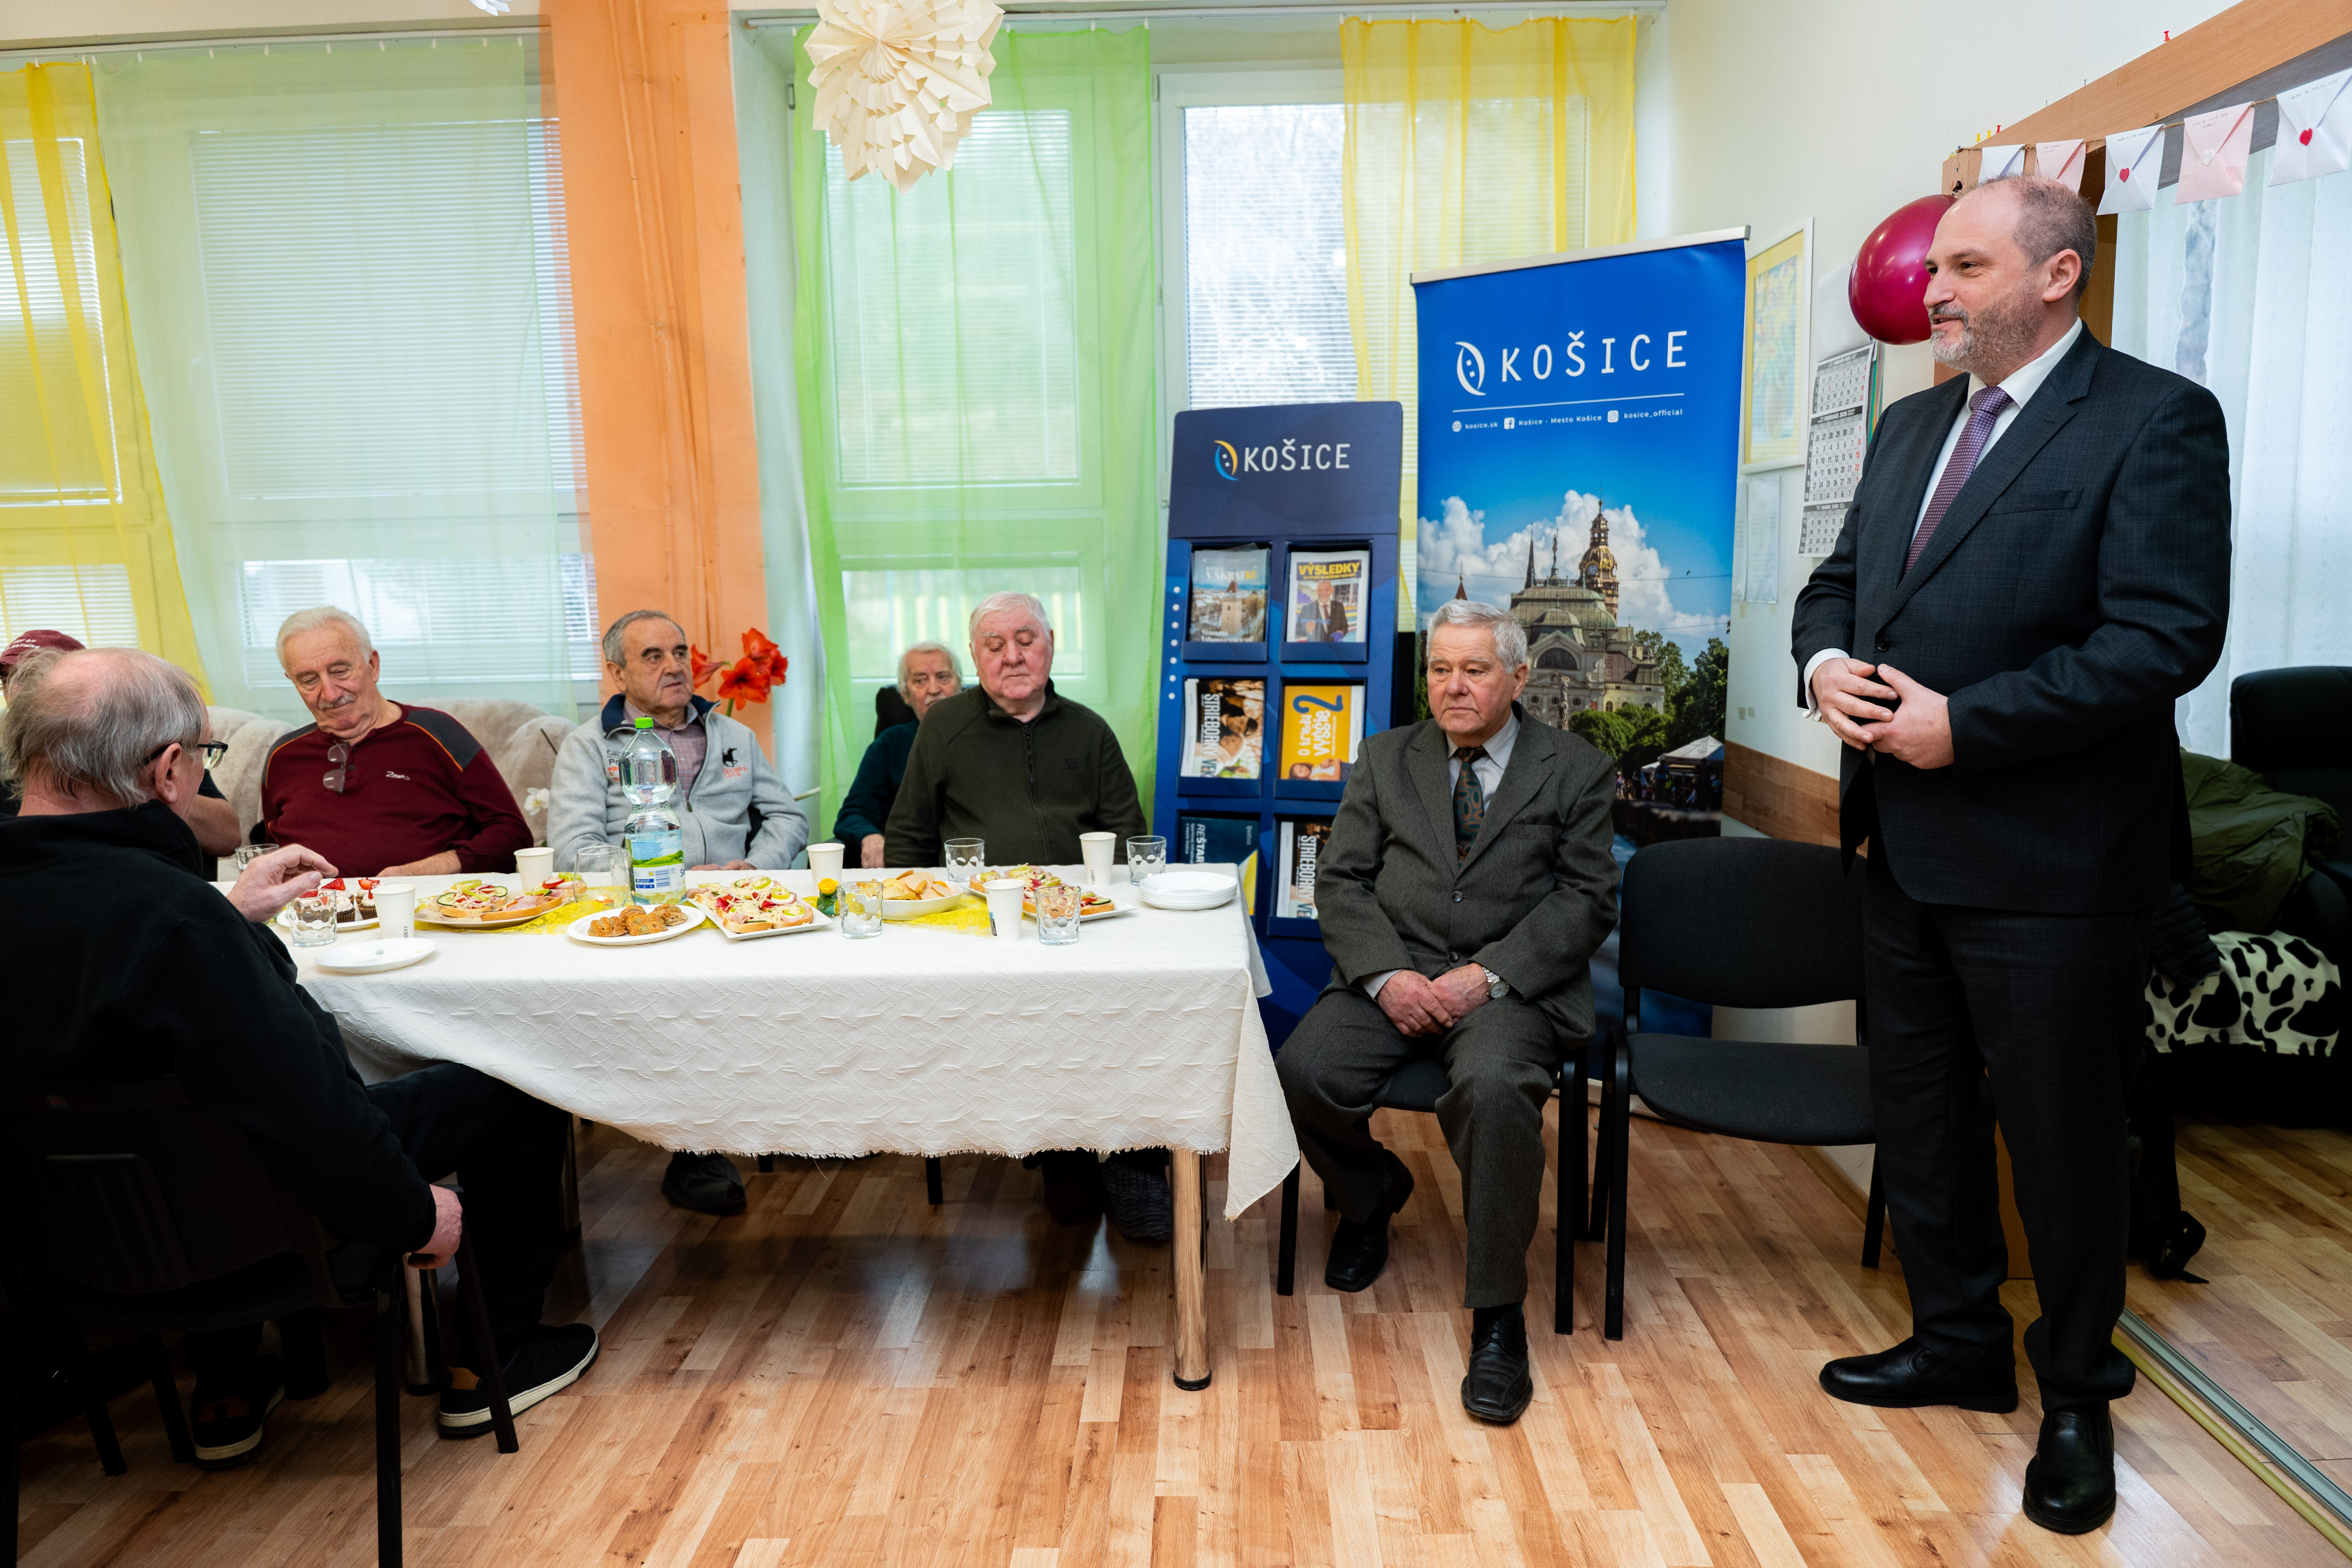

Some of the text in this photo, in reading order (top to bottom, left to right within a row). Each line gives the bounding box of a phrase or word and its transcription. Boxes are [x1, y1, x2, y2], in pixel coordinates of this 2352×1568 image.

[1502, 330, 1687, 382] KOŠICE
[1519, 418, 1543, 426] Košice
[1624, 409, 1682, 419] kosice_official
[1824, 412, 1838, 421] FEBRUÁR
[1244, 438, 1350, 472] KOŠICE
[1298, 562, 1359, 575] VÝSLEDKY
[1292, 695, 1343, 713] 2
[1299, 715, 1312, 746] triedu
[1297, 904, 1313, 918] VE
